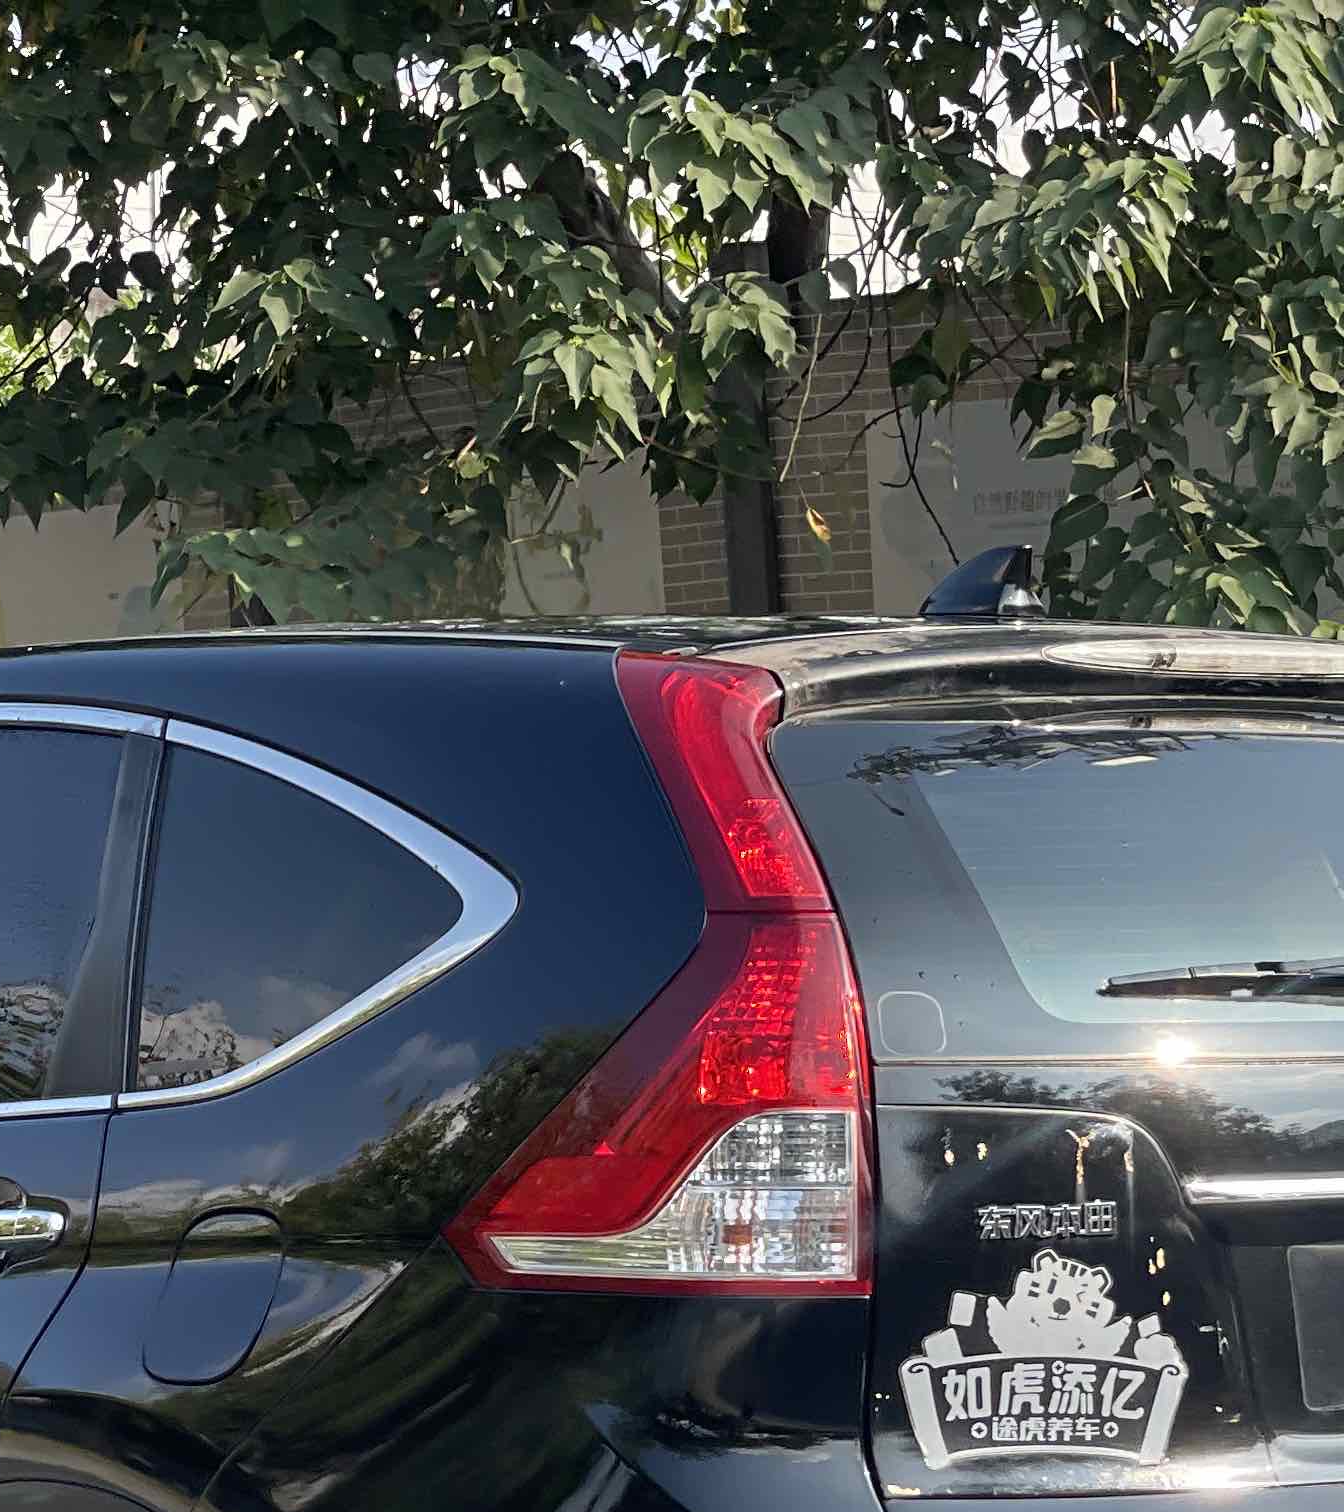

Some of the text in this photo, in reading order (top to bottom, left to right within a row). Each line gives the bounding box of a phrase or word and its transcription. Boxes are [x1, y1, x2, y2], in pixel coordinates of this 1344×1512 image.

[977, 1199, 1118, 1240] 东风本田
[941, 1360, 1146, 1422] 如虎添亿
[991, 1416, 1101, 1441] 途虎养车
